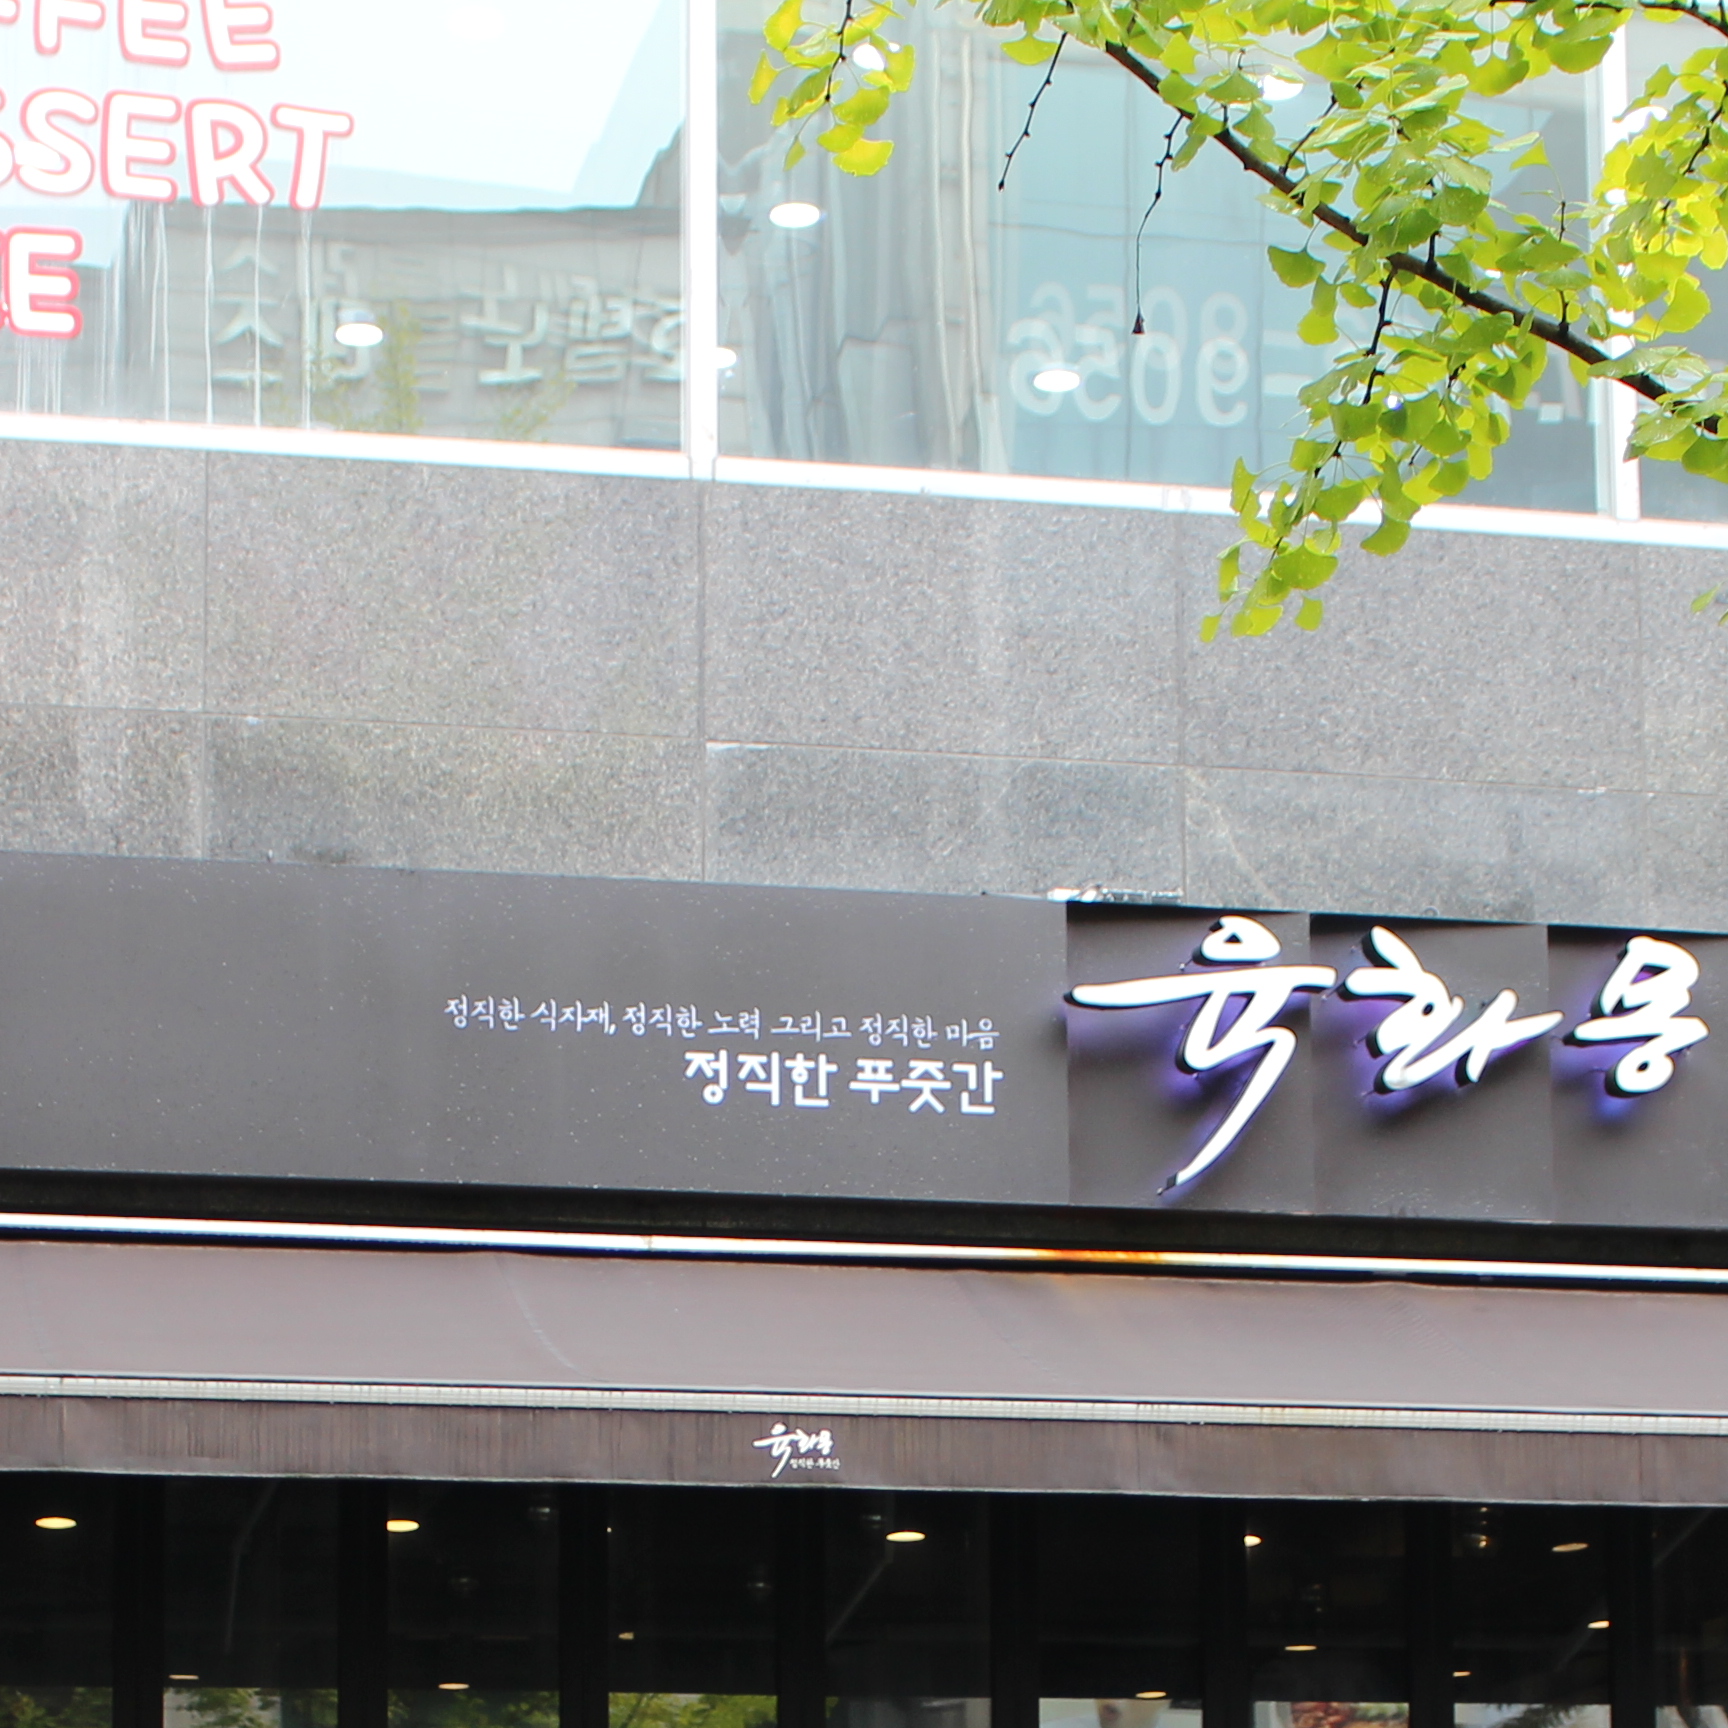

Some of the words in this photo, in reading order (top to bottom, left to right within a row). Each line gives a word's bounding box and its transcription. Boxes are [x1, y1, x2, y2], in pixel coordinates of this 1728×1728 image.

[444, 994, 526, 1031] 정직한
[530, 998, 617, 1036] 식자재,
[622, 1001, 703, 1039] 정직한
[707, 1007, 761, 1040] 노력
[770, 1009, 852, 1042] 그리고
[859, 1012, 938, 1049] 정직한
[944, 1017, 1000, 1050] 마음
[1066, 914, 1710, 1192] 육화몽
[683, 1048, 840, 1108] 정직한
[848, 1056, 1004, 1115] 푸줏간
